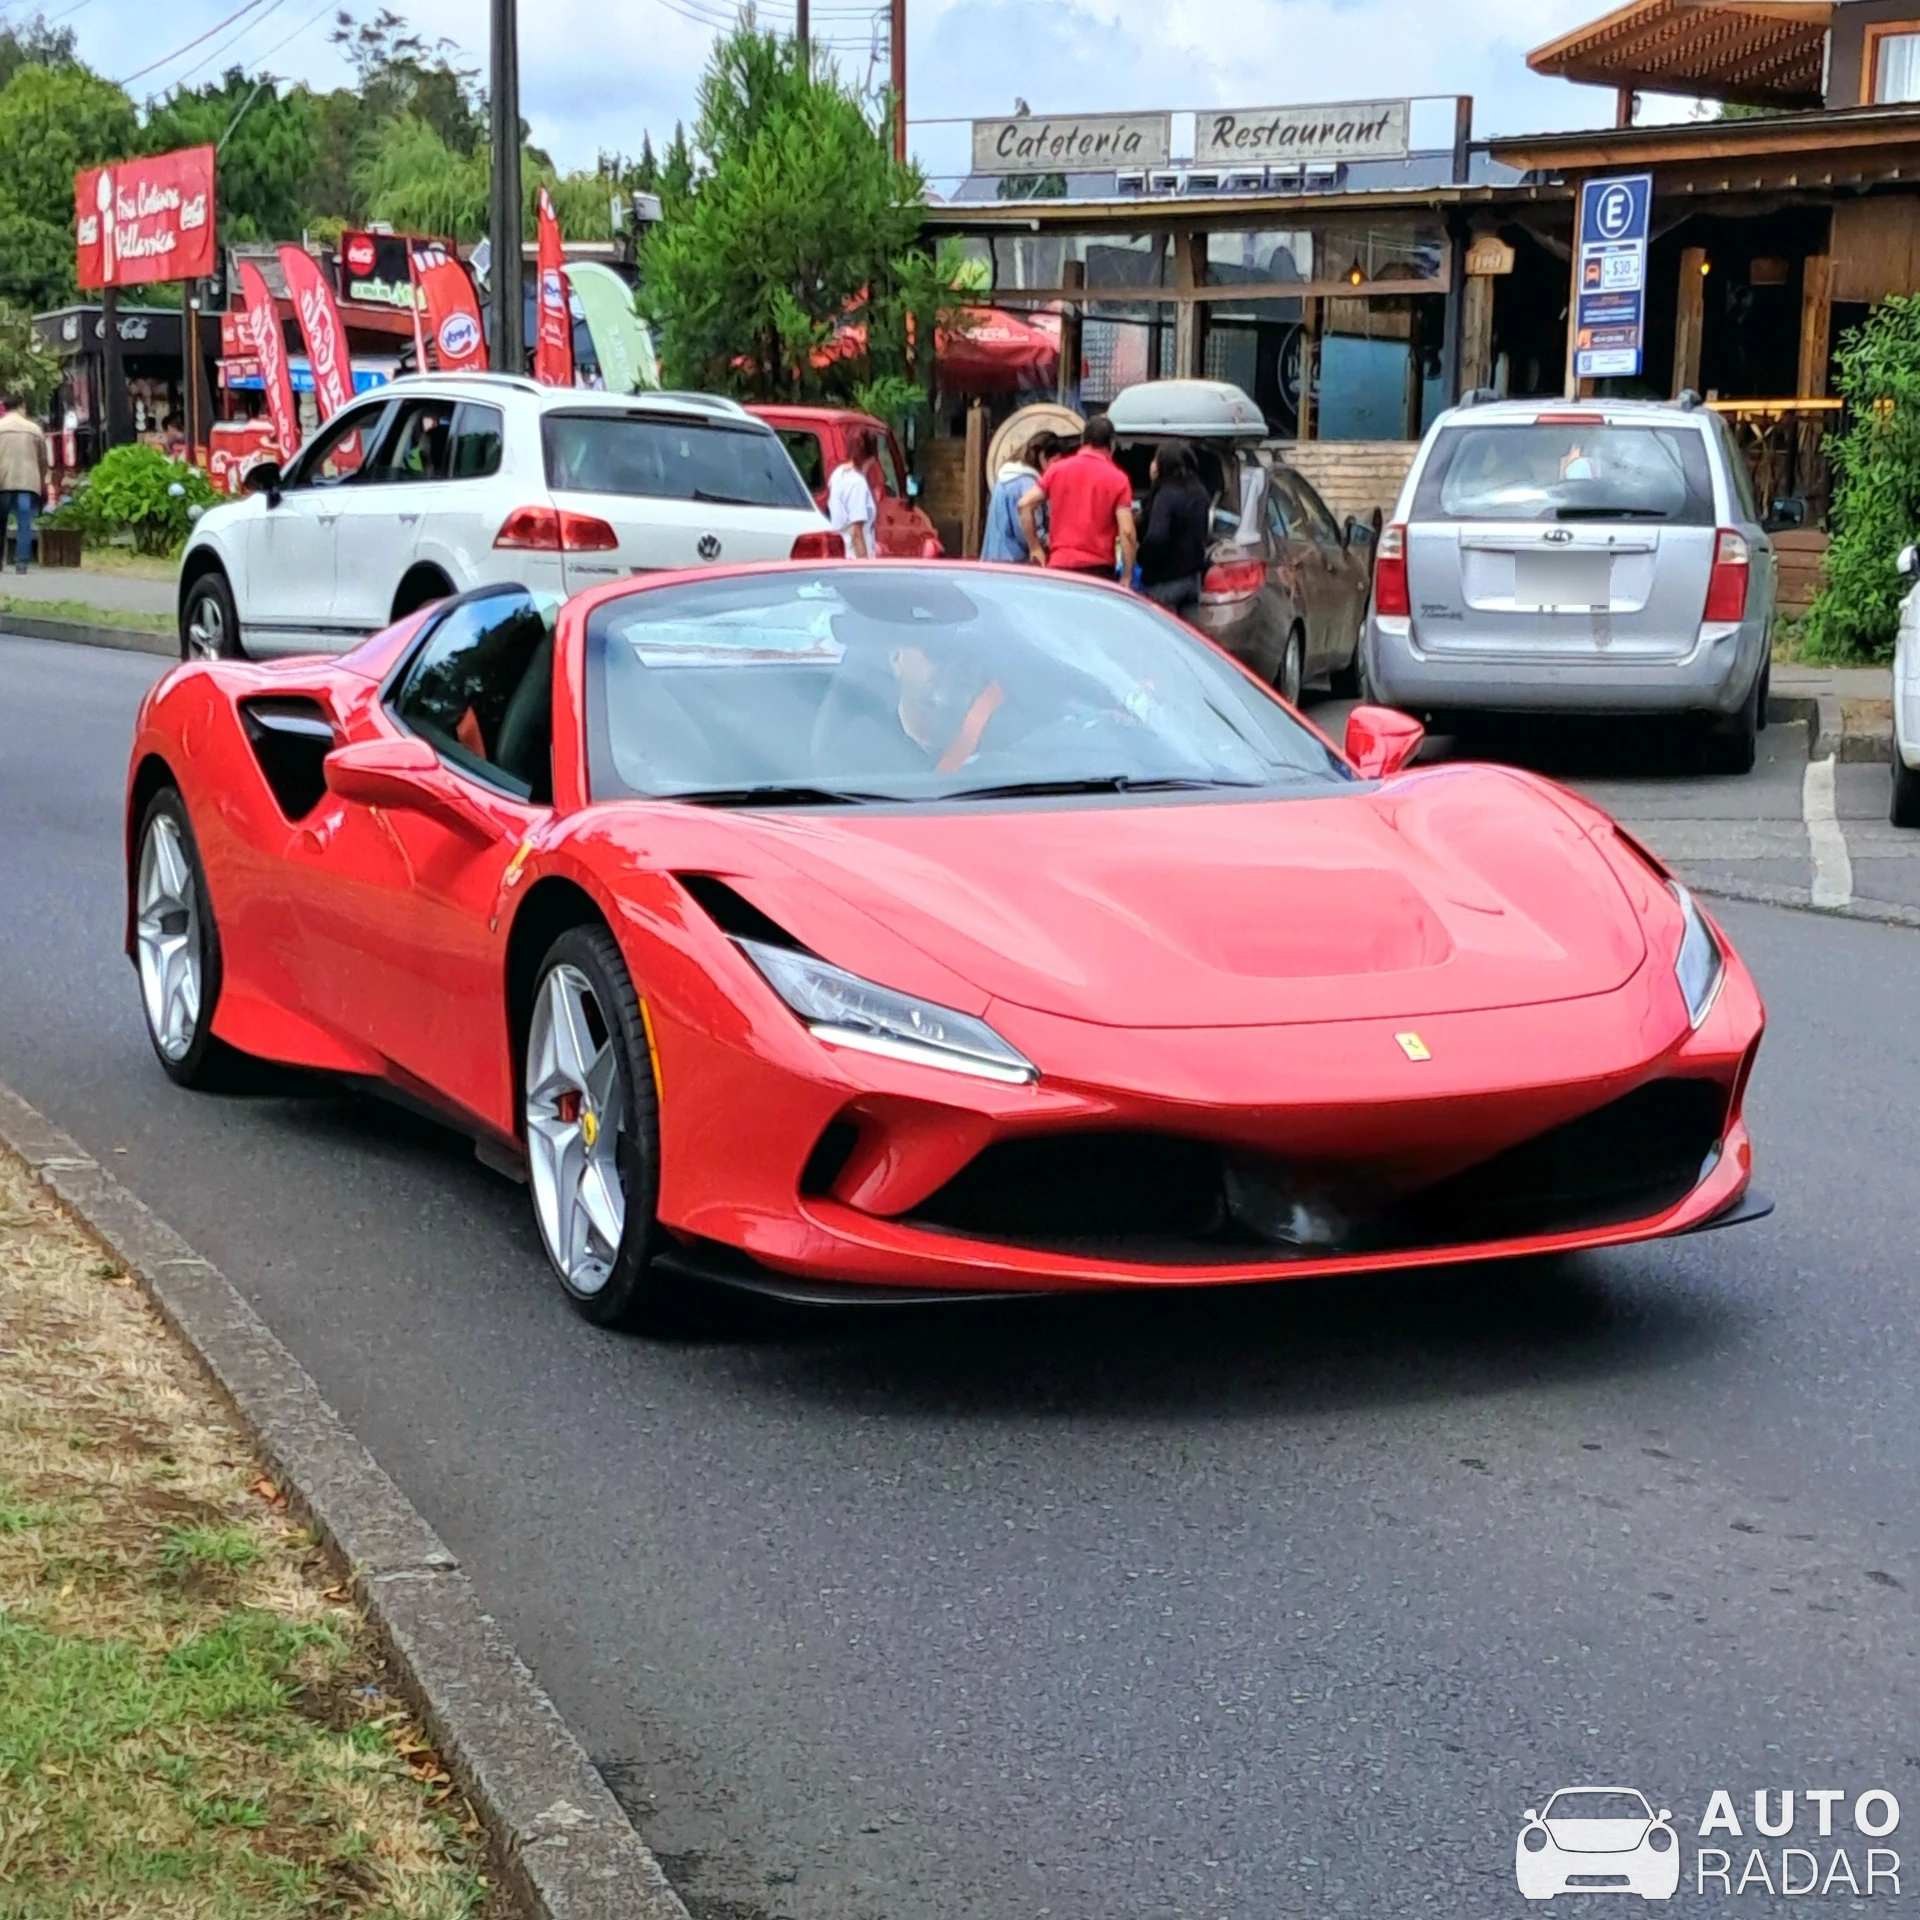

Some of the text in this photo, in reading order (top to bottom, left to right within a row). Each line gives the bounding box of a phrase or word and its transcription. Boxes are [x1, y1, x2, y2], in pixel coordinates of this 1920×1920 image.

[996, 124, 1143, 159] Cafetería
[1211, 111, 1391, 149] Restaurant
[1606, 194, 1625, 228] E
